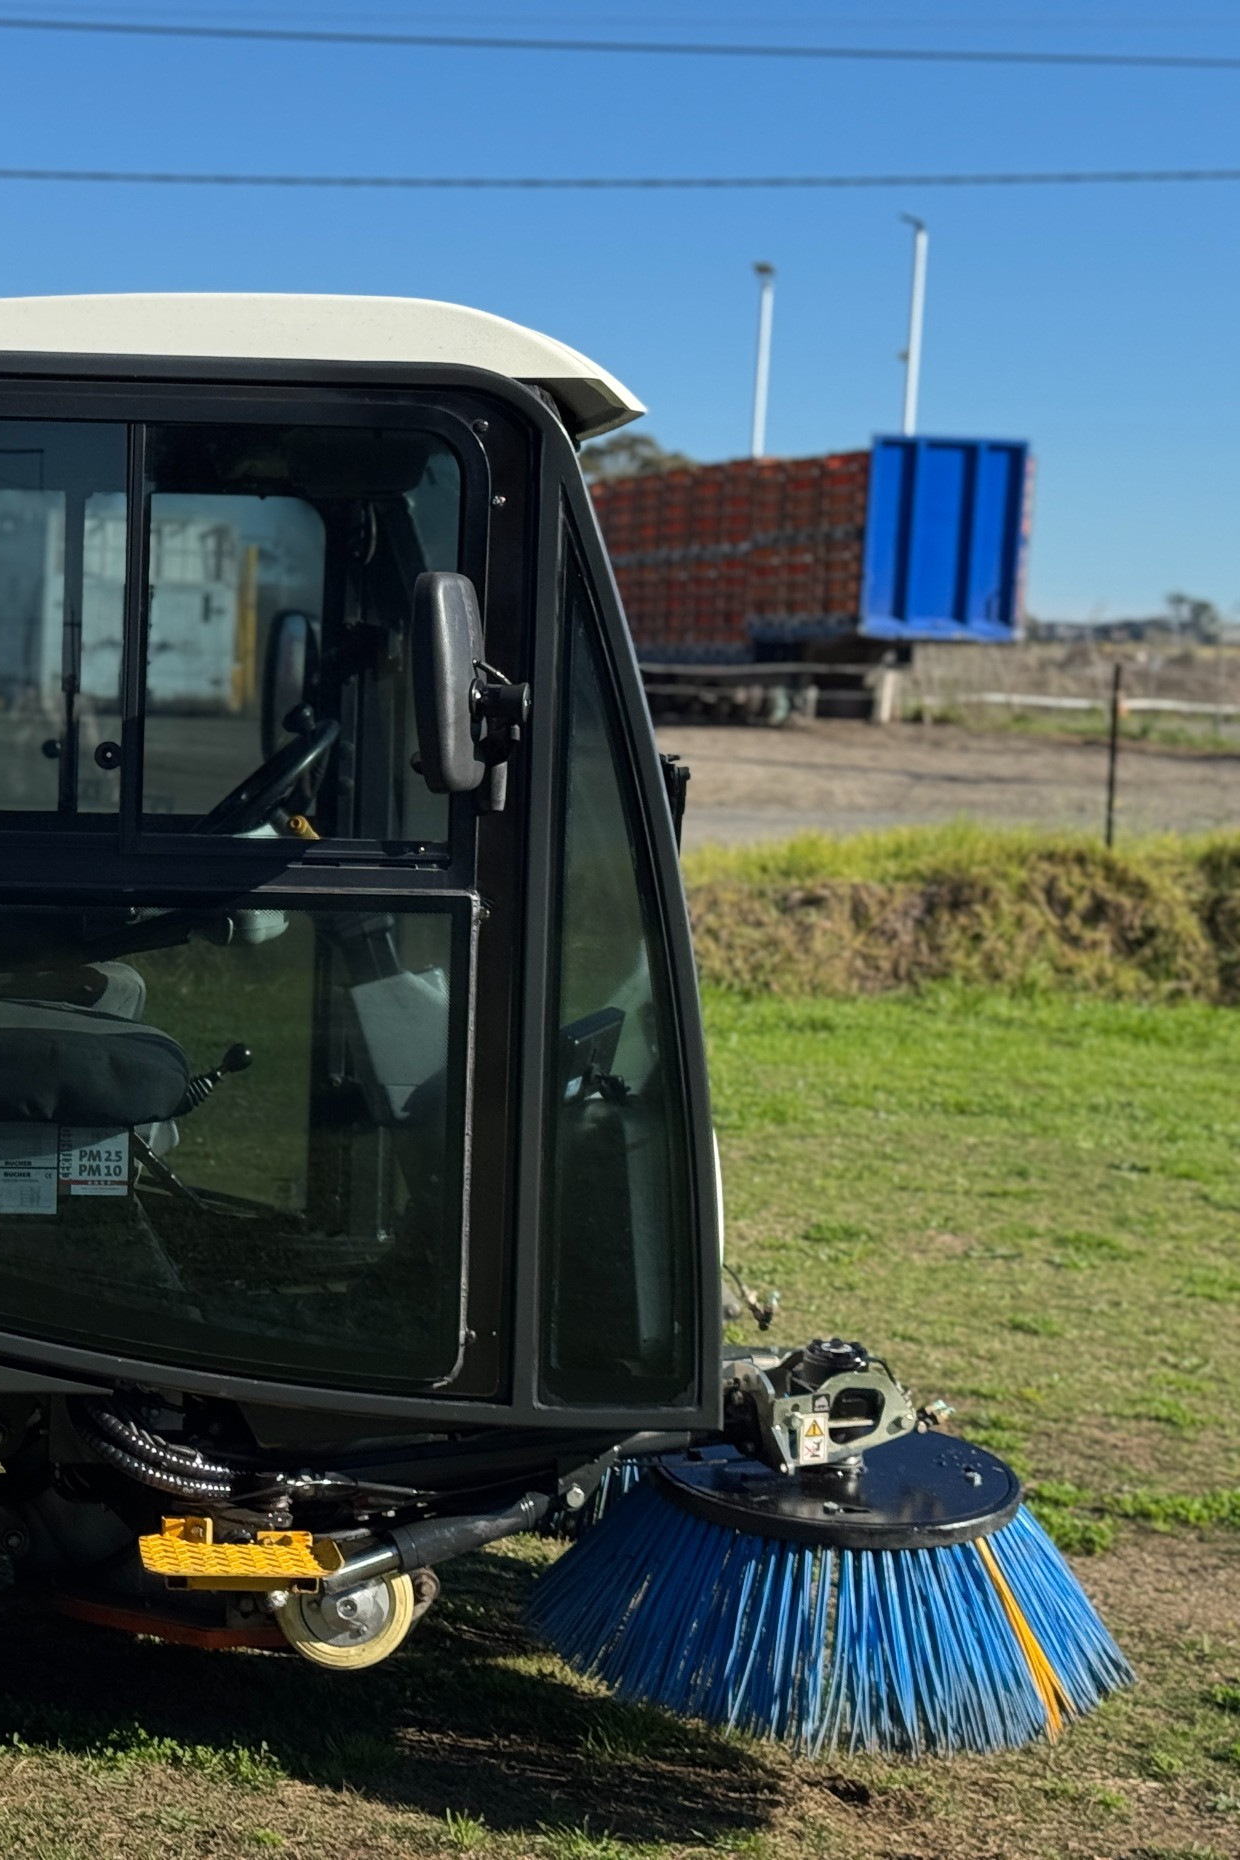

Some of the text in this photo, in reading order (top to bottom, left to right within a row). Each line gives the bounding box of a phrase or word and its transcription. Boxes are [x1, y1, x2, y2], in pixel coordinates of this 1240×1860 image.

[78, 1149, 102, 1162] PM
[78, 1163, 123, 1177] PM 10
